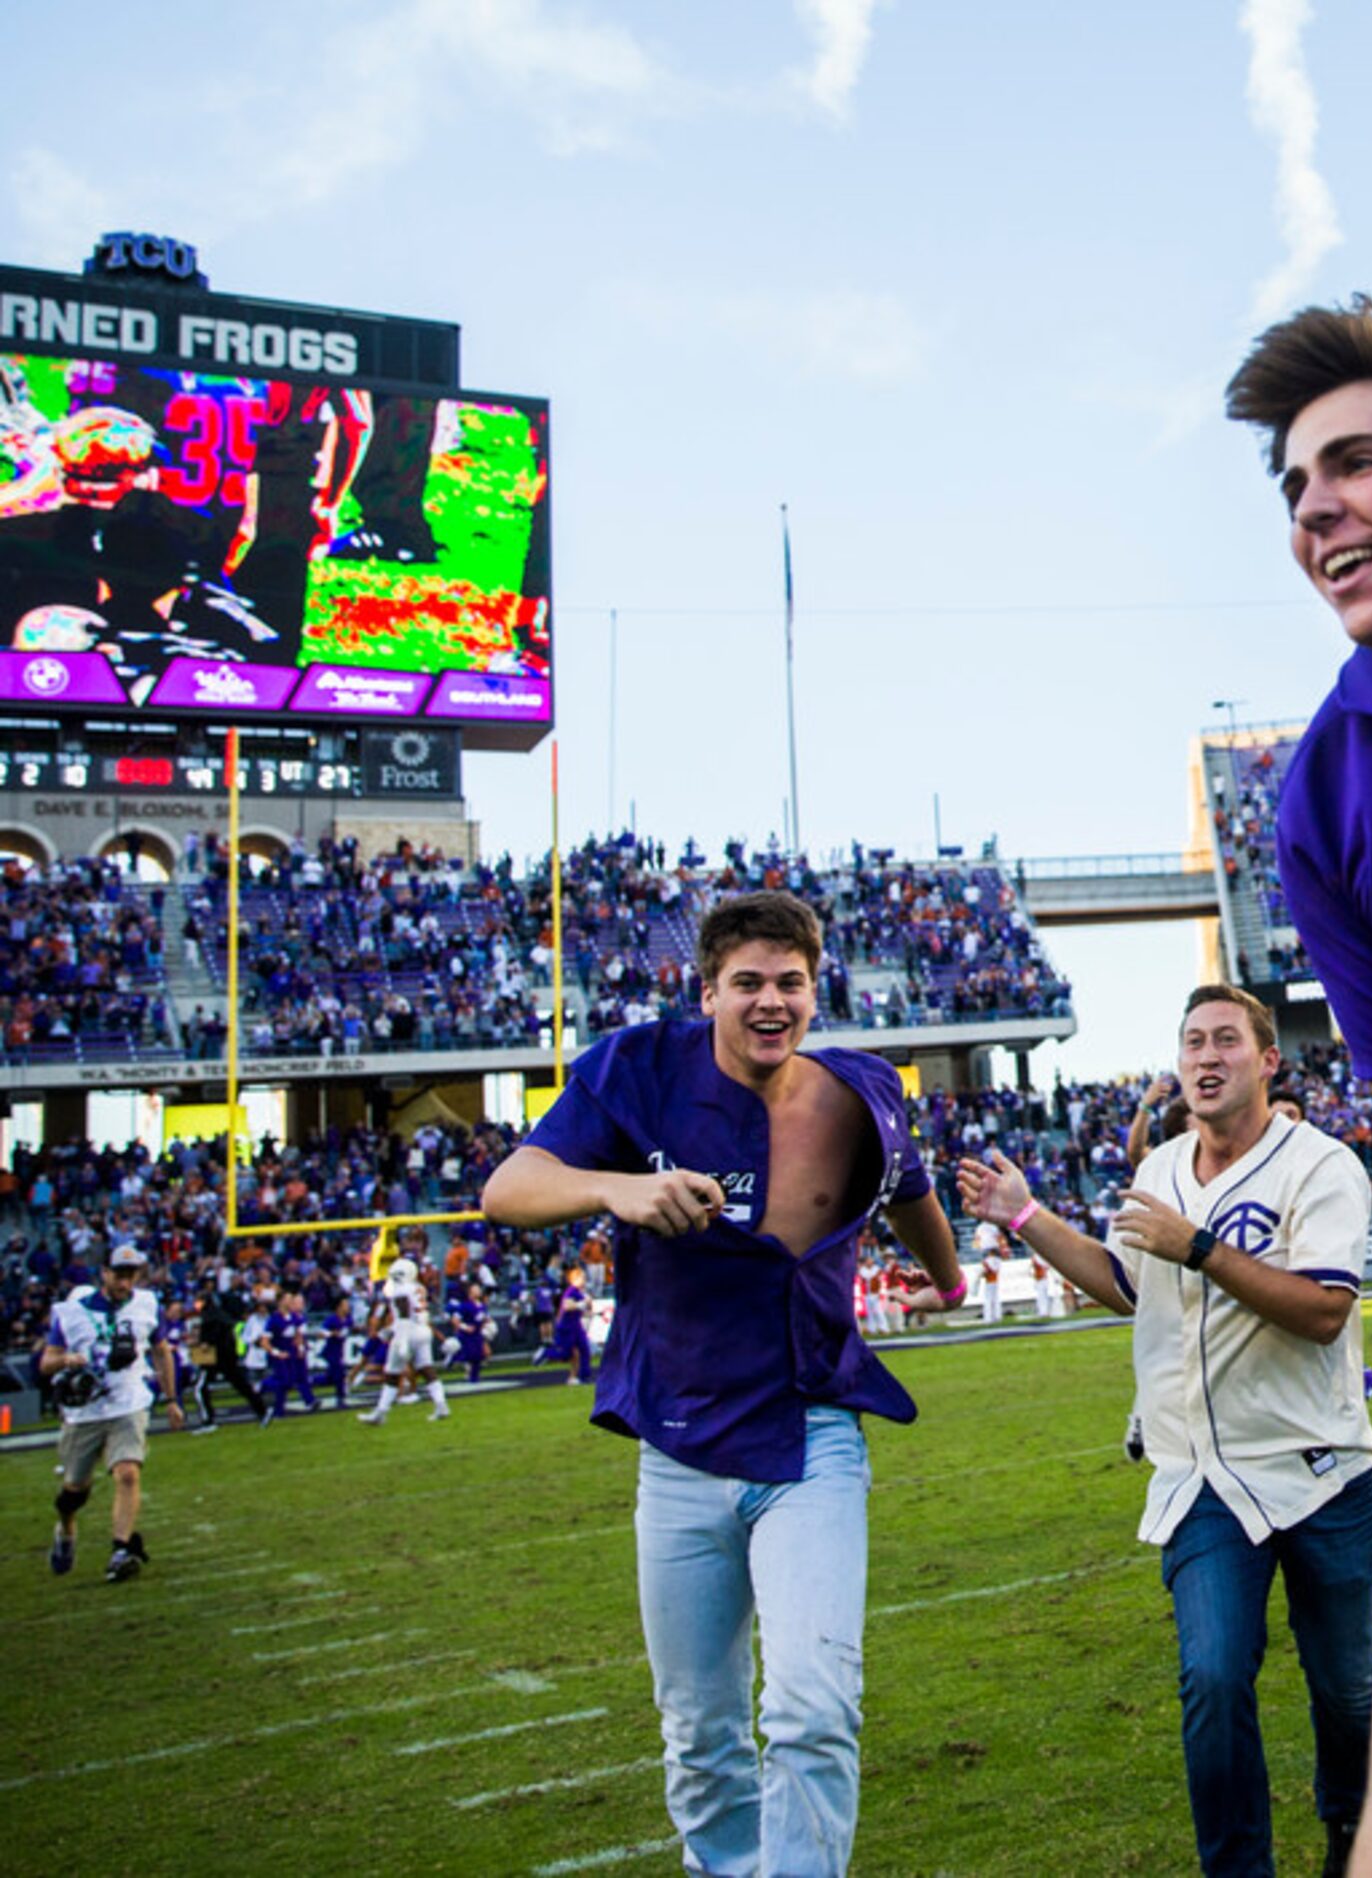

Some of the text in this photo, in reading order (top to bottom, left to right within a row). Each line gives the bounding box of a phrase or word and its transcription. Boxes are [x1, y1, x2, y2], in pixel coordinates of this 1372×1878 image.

[102, 231, 197, 278] TCU
[0, 293, 358, 376] RNED FROGS
[381, 765, 439, 789] Frost
